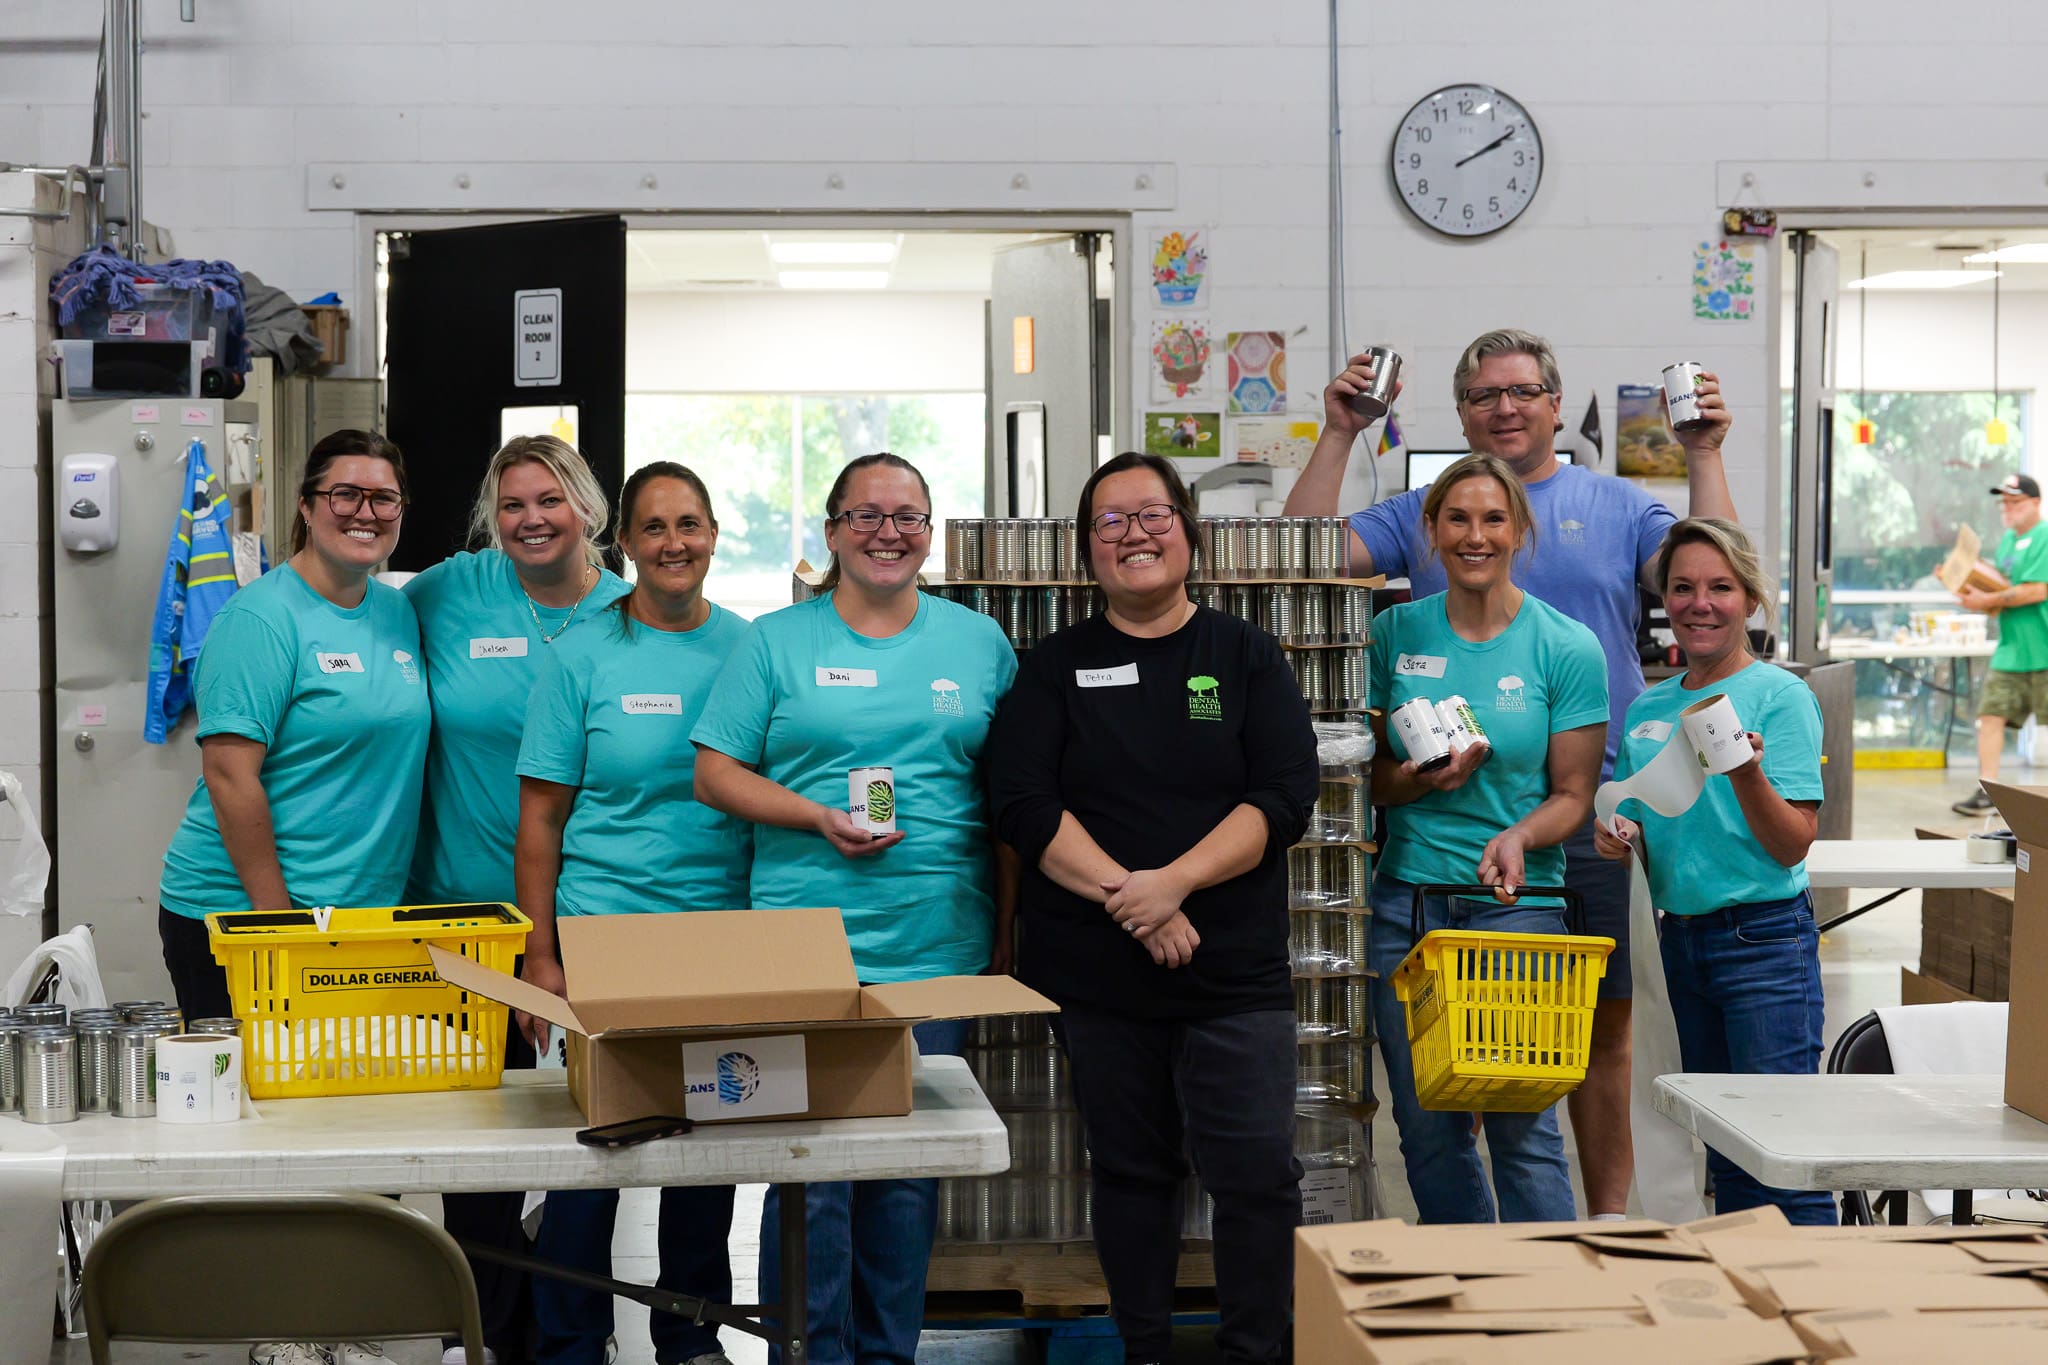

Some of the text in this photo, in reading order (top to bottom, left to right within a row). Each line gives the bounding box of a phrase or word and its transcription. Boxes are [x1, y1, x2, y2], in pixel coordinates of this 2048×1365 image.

[1434, 108, 1448, 123] 11
[1458, 100, 1473, 116] 12
[1414, 126, 1432, 143] 10
[1410, 153, 1421, 169] 9
[1513, 151, 1525, 167] 3
[1417, 179, 1429, 195] 8
[1506, 177, 1517, 192] 4
[1437, 198, 1448, 213] 7
[1462, 204, 1474, 220] 6
[1488, 197, 1500, 212] 5
[523, 314, 553, 325] CLEAN
[525, 332, 552, 343] ROOM
[535, 351, 541, 361] 2
[1403, 659, 1427, 669] Sera
[828, 671, 850, 681] Dani
[1085, 674, 1112, 682] Petra
[629, 700, 674, 709] Stephanie
[309, 971, 441, 986] DOLLAR GENERAL
